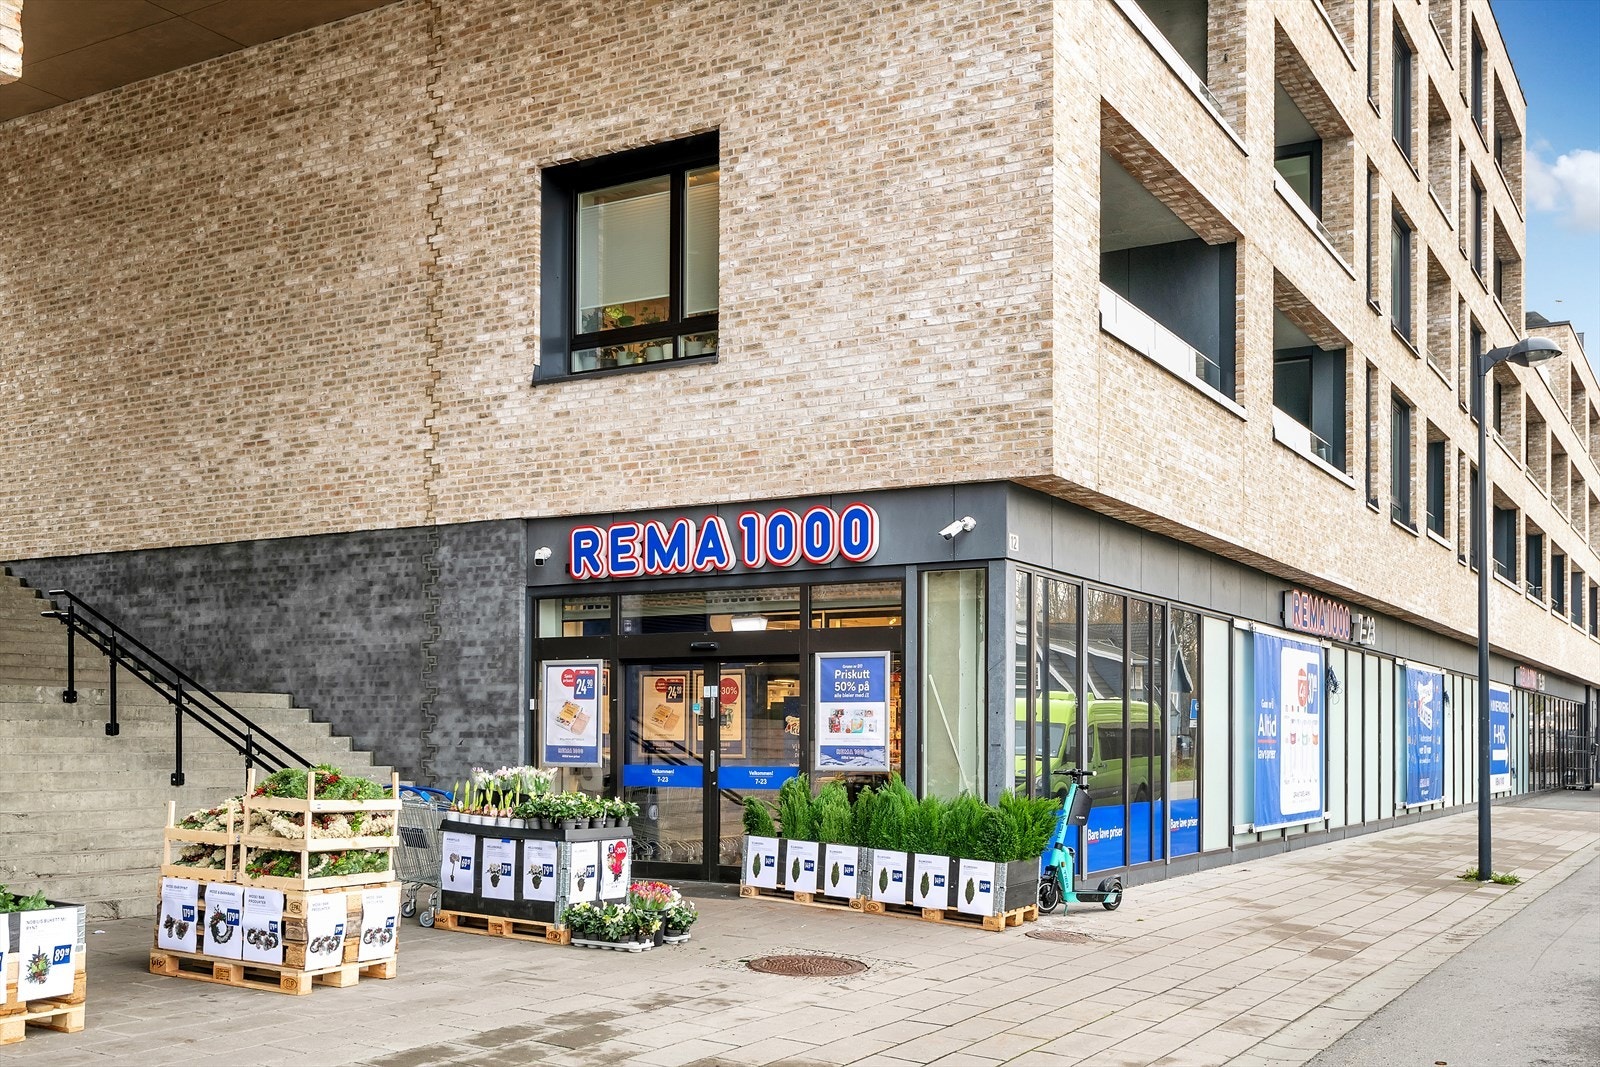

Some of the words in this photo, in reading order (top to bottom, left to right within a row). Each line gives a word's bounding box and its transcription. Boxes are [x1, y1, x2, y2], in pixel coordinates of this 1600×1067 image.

[569, 514, 736, 580] REMA
[738, 502, 879, 568] 1000
[1292, 588, 1326, 635] REMA
[1326, 599, 1350, 641] 1000
[834, 669, 870, 679] Priskutt
[834, 681, 856, 691] 50%
[858, 680, 870, 693] på
[1257, 713, 1277, 737] Alltid
[1170, 818, 1179, 829] Bare
[1179, 818, 1187, 828] lave
[1187, 816, 1199, 830] priser
[1087, 829, 1098, 841] Bare
[1099, 827, 1110, 839] lave
[1110, 826, 1123, 841] priser
